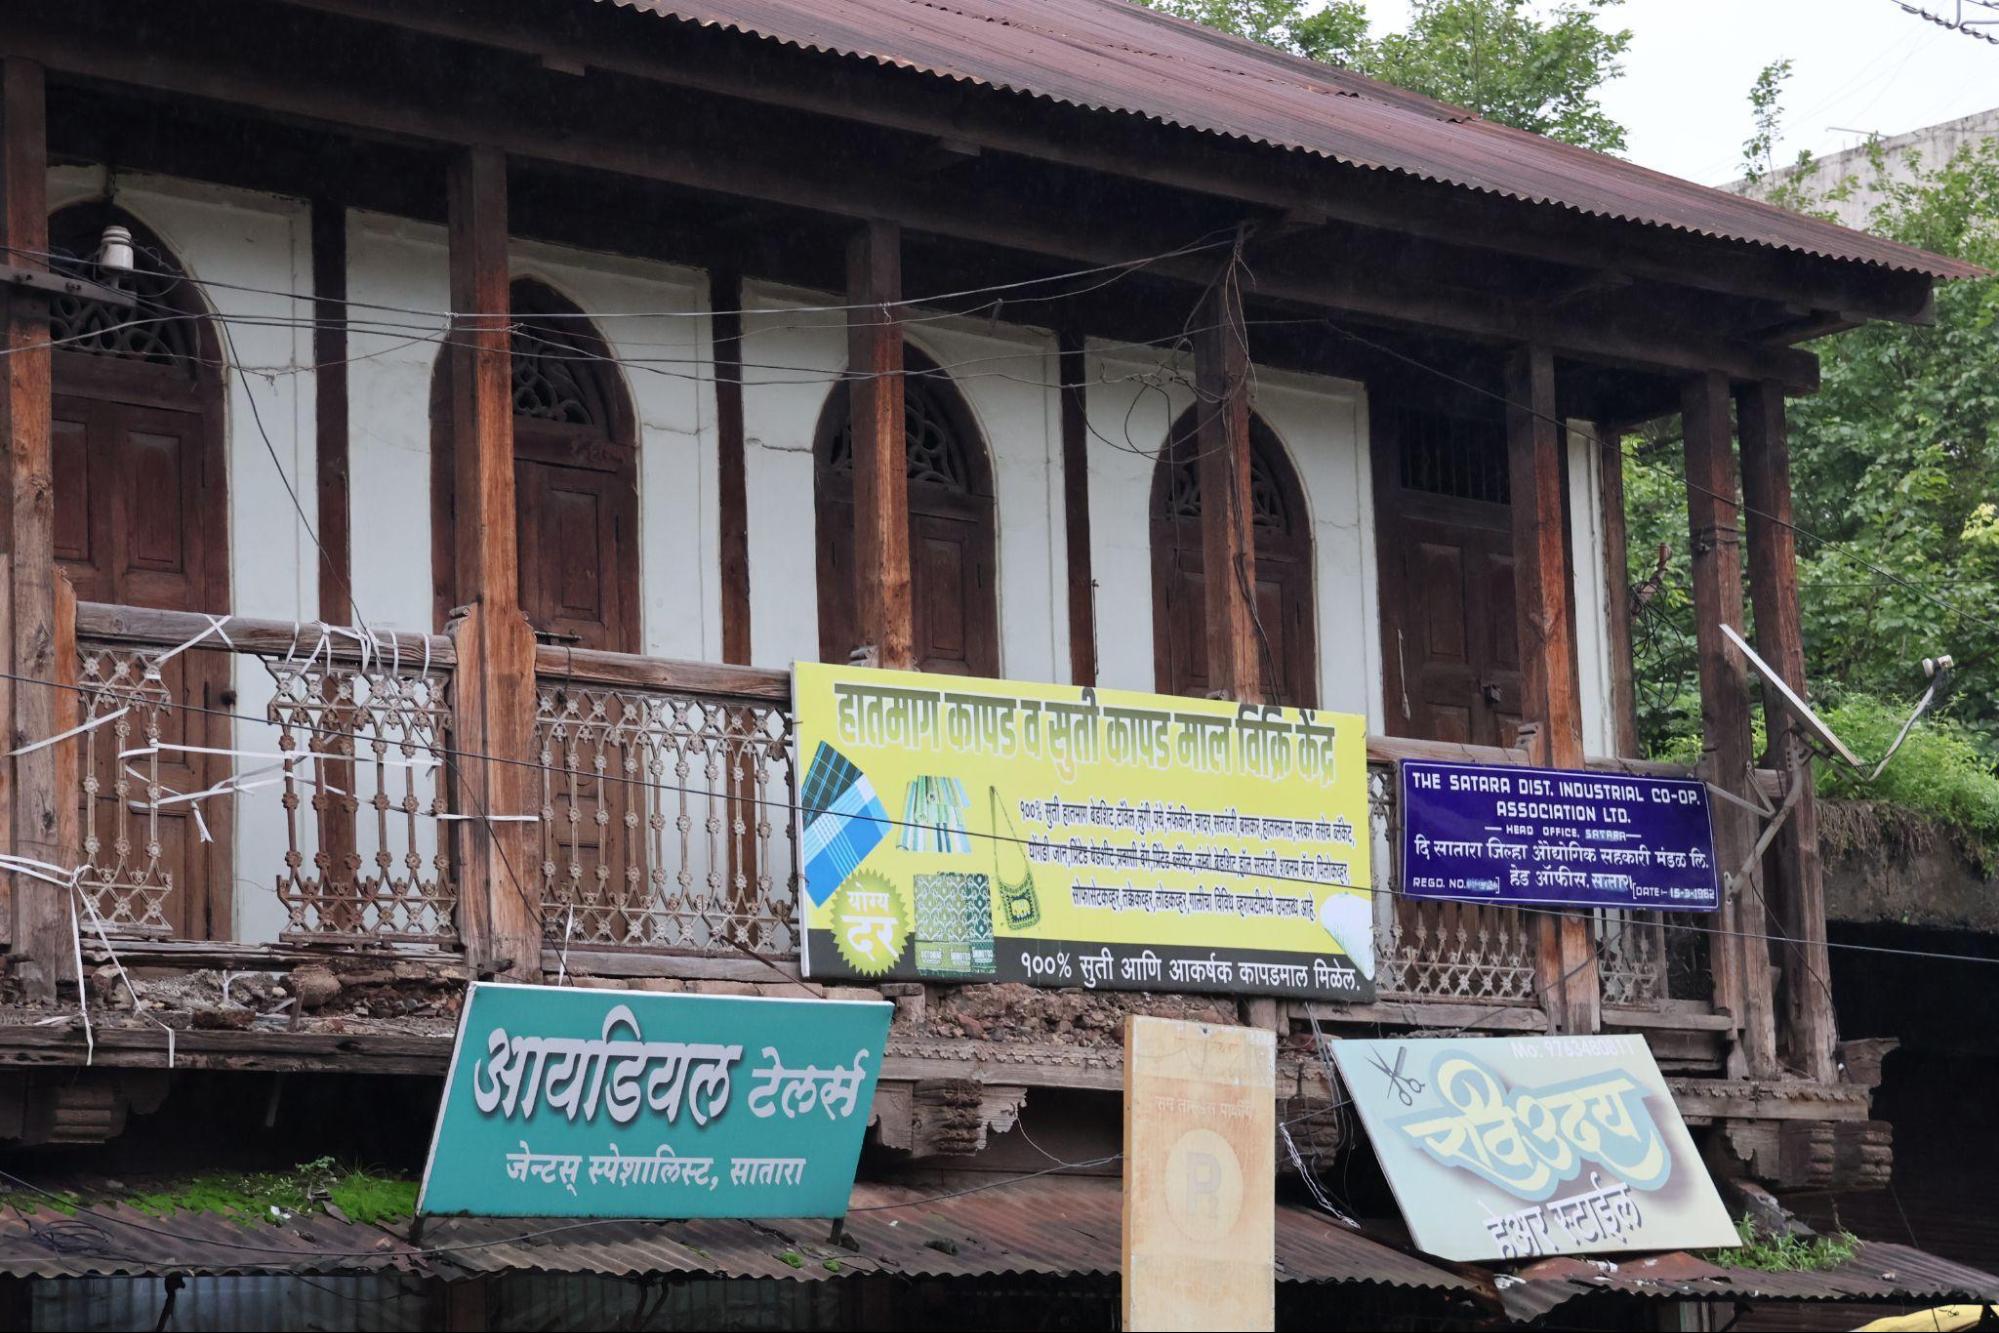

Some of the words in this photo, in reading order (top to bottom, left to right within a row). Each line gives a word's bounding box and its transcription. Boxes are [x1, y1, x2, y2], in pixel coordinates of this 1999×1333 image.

[834, 683, 941, 749] हातमाग
[945, 693, 1017, 758] कापड
[1020, 700, 1042, 760] व
[1045, 687, 1099, 781] सुती
[1103, 707, 1171, 770] कापड
[1174, 713, 1232, 774] माल
[1412, 772, 1441, 790] THE
[1449, 774, 1512, 794] SATARA
[1518, 778, 1553, 796] DIST.
[1559, 781, 1644, 802] INDUSTRIAL
[1651, 787, 1701, 805] CO-OP.
[1045, 796, 1060, 830] सुती
[1496, 800, 1596, 822] ASSOCIATION
[1603, 807, 1632, 824] LTD.
[1506, 824, 1534, 836] HEAD
[1414, 833, 1430, 860] दि
[1433, 839, 1482, 859] सातारा
[1486, 837, 1528, 861] जिल्हा
[1532, 839, 1597, 864] औद्योगिक
[1600, 843, 1651, 867] सहकारी
[1654, 845, 1688, 869] मंडळ
[1689, 847, 1709, 869] लि.
[1412, 877, 1445, 888] REGD.
[1510, 864, 1530, 887] हेड
[1535, 864, 1589, 889] ऑफीस.
[847, 882, 890, 913] योग्य
[841, 914, 900, 962] दर
[1020, 951, 1072, 979] १००%
[1079, 947, 1114, 988] सुती
[1121, 950, 1162, 983] आणि
[1168, 952, 1232, 985] आकर्षक
[1237, 960, 1308, 988] कापडमाल
[1313, 958, 1361, 991] मिळेल.
[474, 1004, 743, 1126] आयडियल
[747, 1046, 870, 1121] टेलर्स
[506, 1141, 582, 1196] जेन्टस्
[588, 1143, 719, 1190] स्पेशालिस्ट,
[730, 1156, 806, 1185] सातारा
